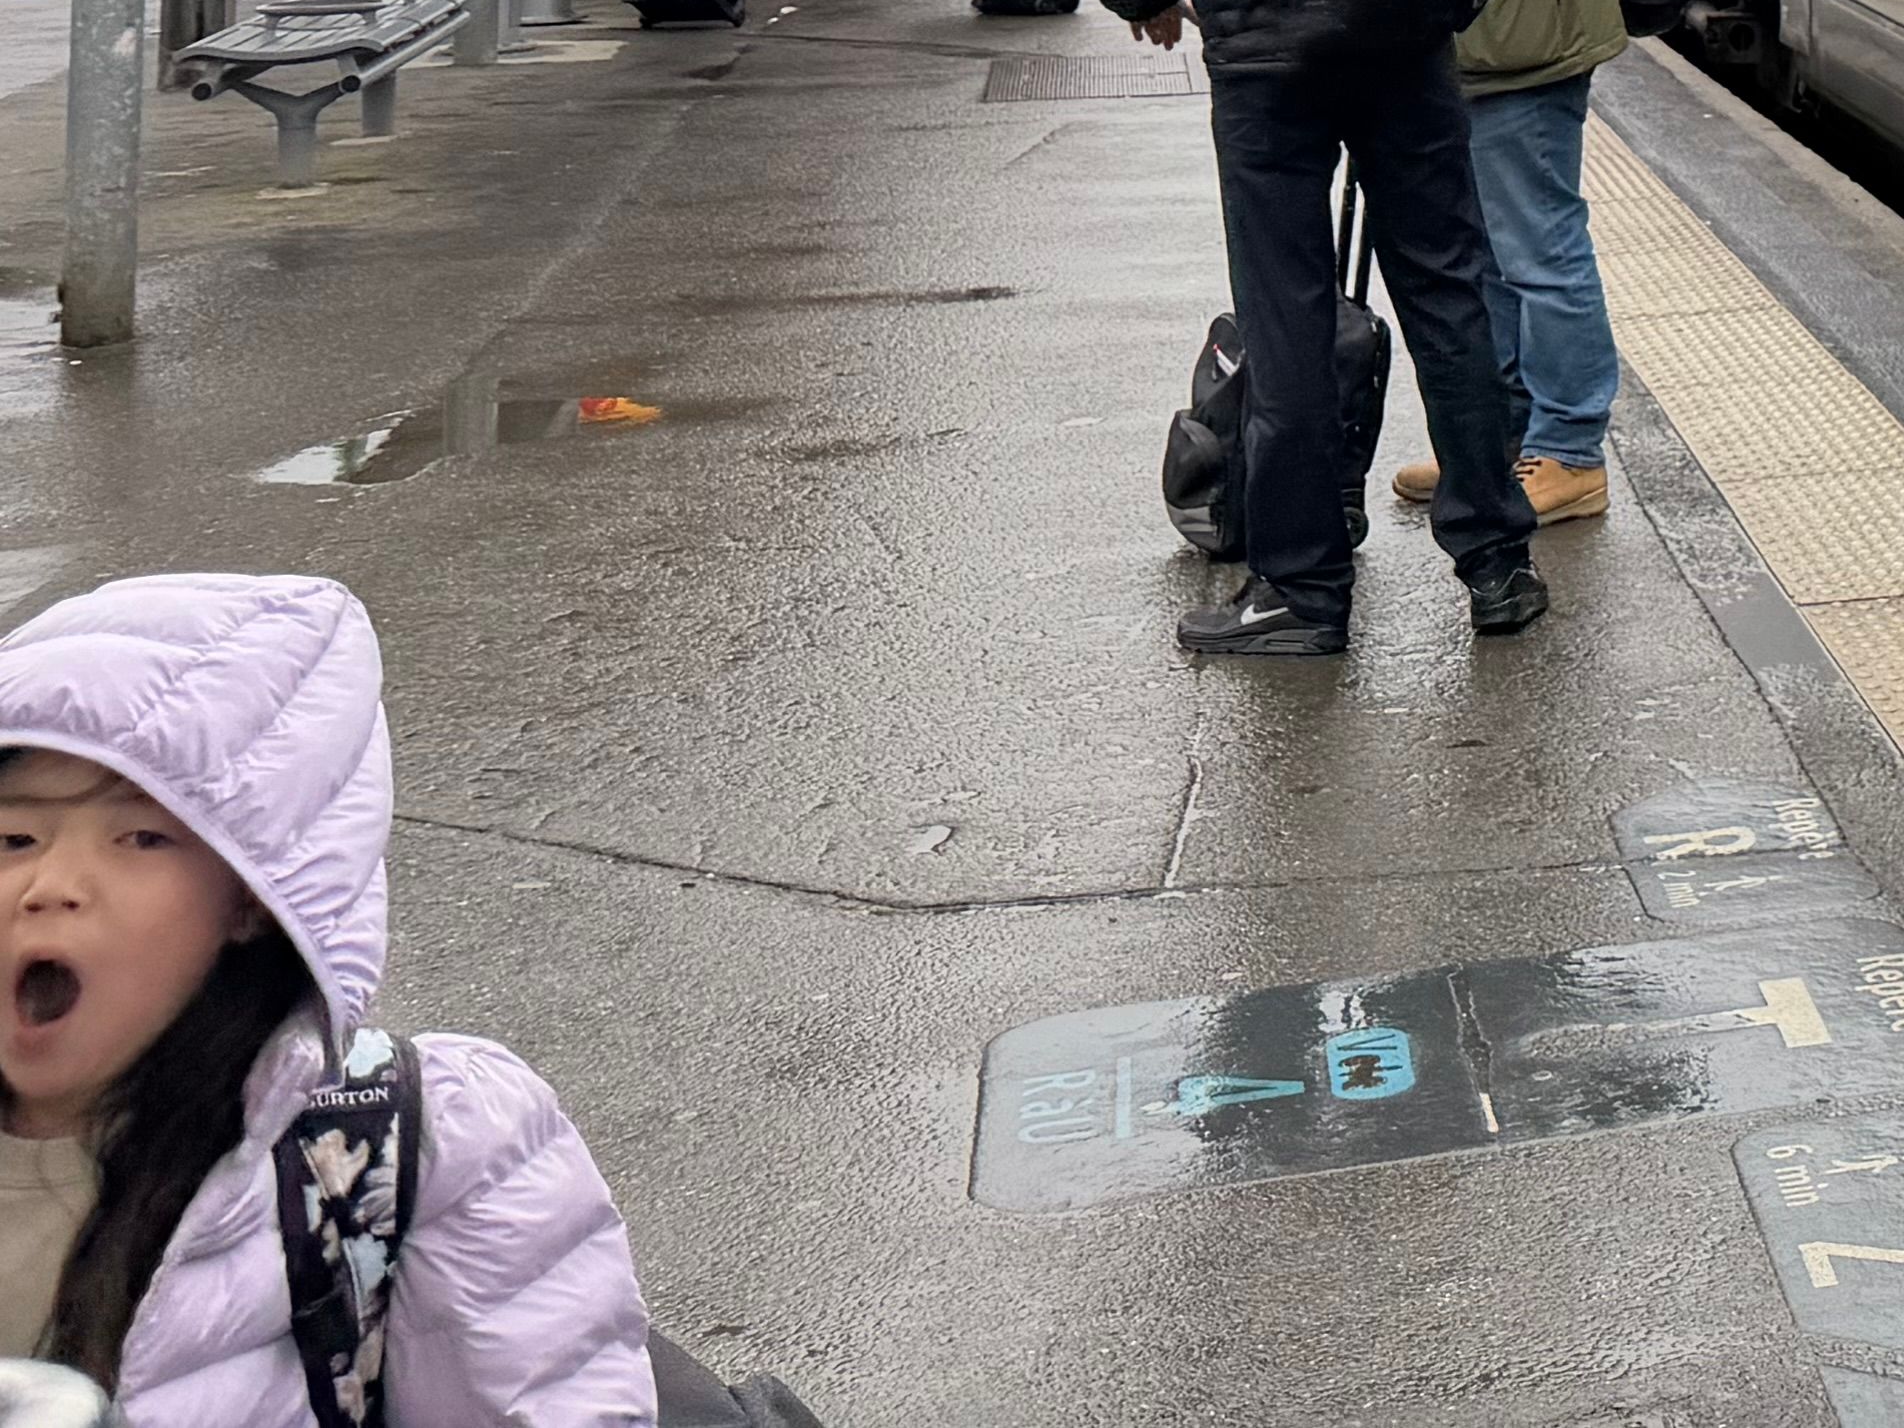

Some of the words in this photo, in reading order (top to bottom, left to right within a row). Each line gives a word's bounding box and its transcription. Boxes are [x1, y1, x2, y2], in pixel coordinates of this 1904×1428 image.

[1644, 826, 1755, 860] R
[310, 1086, 389, 1107] URTON
[1766, 1144, 1814, 1160] 6
[1775, 1163, 1829, 1207] min
